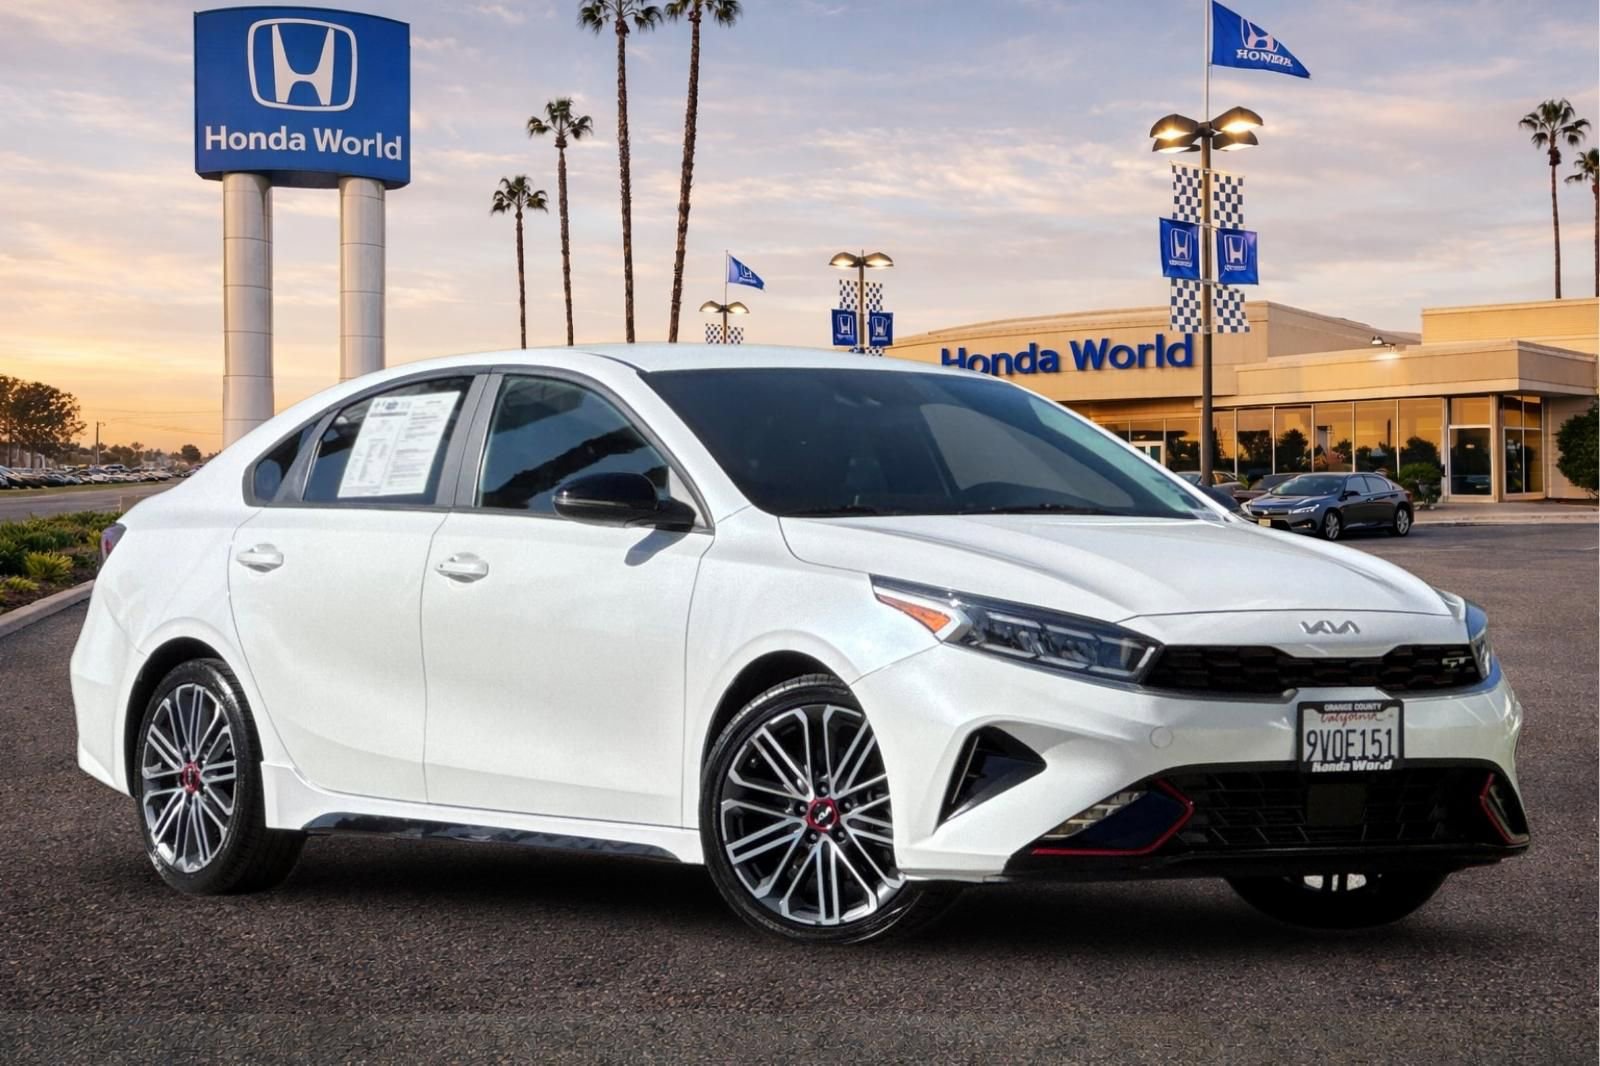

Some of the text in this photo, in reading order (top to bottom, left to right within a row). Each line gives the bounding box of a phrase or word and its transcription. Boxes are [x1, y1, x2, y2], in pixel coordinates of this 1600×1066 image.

[205, 125, 402, 161] Honda World
[941, 333, 1194, 376] Honda World
[1324, 702, 1382, 711] ORANGE COUNTY
[1312, 761, 1350, 772] Honda
